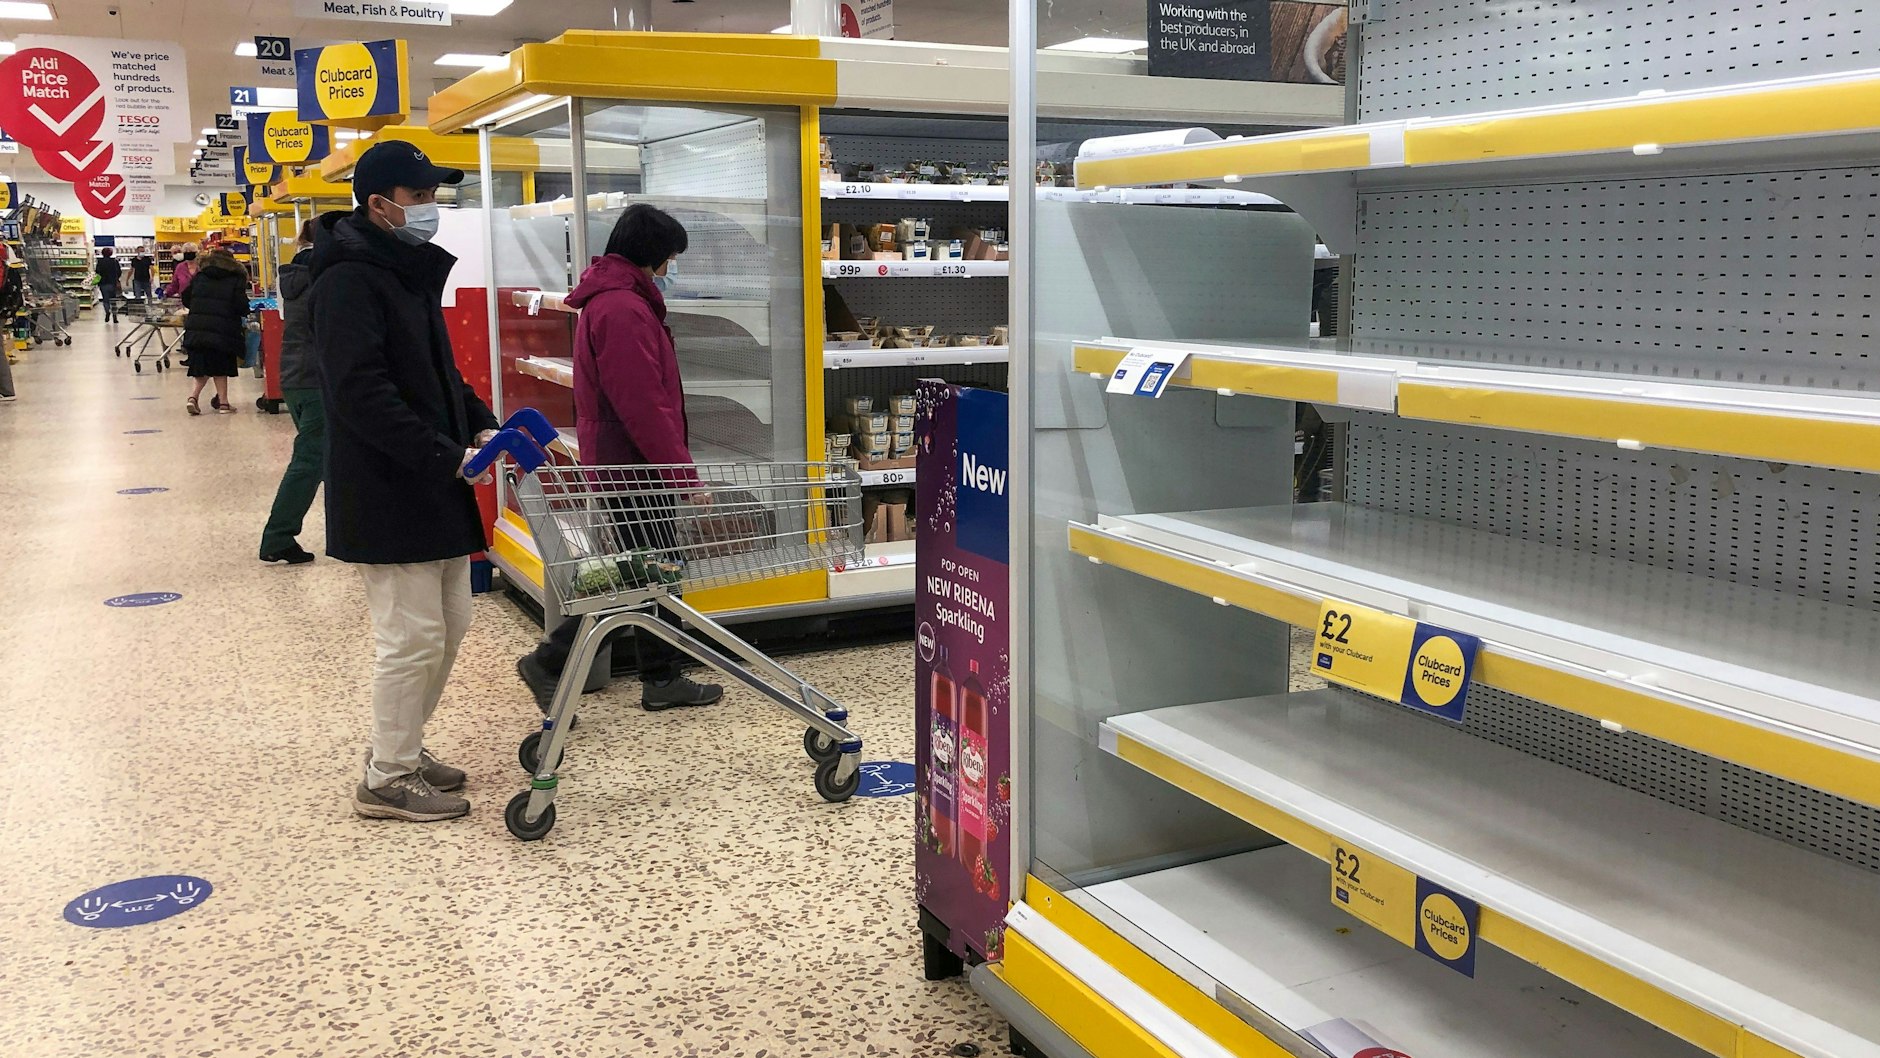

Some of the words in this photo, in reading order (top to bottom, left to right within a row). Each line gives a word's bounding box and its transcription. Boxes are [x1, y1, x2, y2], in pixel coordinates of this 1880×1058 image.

[324, 2, 359, 15] Meat,
[362, 4, 387, 16] Fish
[390, 6, 398, 16] &
[401, 6, 444, 21] Poultry
[1160, 3, 1204, 21] Working
[1206, 8, 1228, 20] with
[1230, 9, 1247, 22] the
[1160, 20, 1183, 34] best
[1184, 23, 1238, 39] producers,
[1240, 26, 1248, 38] in
[260, 40, 284, 56] 20
[1160, 37, 1178, 50] the
[1180, 38, 1197, 51] UK
[1198, 40, 1218, 52] and
[1220, 41, 1256, 54] abroad
[30, 57, 58, 69] Aldi
[111, 51, 141, 59] We've
[144, 52, 170, 62] price
[113, 63, 156, 71] matched
[262, 66, 286, 76] Meat
[320, 66, 372, 83] Clubcard
[22, 70, 68, 86] Price
[114, 73, 160, 82] hundreds
[23, 86, 69, 98] Match
[128, 85, 174, 94] products.
[234, 90, 249, 103] 21
[329, 86, 365, 100] Prices
[117, 115, 159, 124] TESCO
[219, 116, 234, 127] 22
[268, 126, 309, 137] Clubcard
[276, 140, 303, 149] Prices
[846, 185, 871, 194] £2.10
[839, 265, 860, 275] 99p
[942, 266, 966, 274] £1.30
[883, 473, 904, 482] 80p
[962, 452, 1006, 496] New
[942, 558, 956, 572] POP
[958, 565, 979, 582] OPEN
[927, 576, 951, 598] NEW
[954, 583, 995, 621] RIBENA
[936, 602, 984, 644] Sparkling
[1321, 610, 1351, 644] £2
[920, 634, 933, 650] NEW
[1320, 641, 1331, 650] with
[1332, 646, 1345, 654] your
[1346, 648, 1373, 663] Clubcard
[1418, 655, 1461, 676] Clubcard
[1422, 670, 1451, 688] Prices
[964, 752, 983, 772] Ribena
[1336, 848, 1360, 884] £2
[1336, 876, 1346, 885] with
[1347, 882, 1359, 891] your
[1360, 889, 1384, 906] Clubcard
[125, 904, 154, 913] 2m
[1424, 909, 1465, 936] Clubcard
[1431, 923, 1458, 944] Prices
